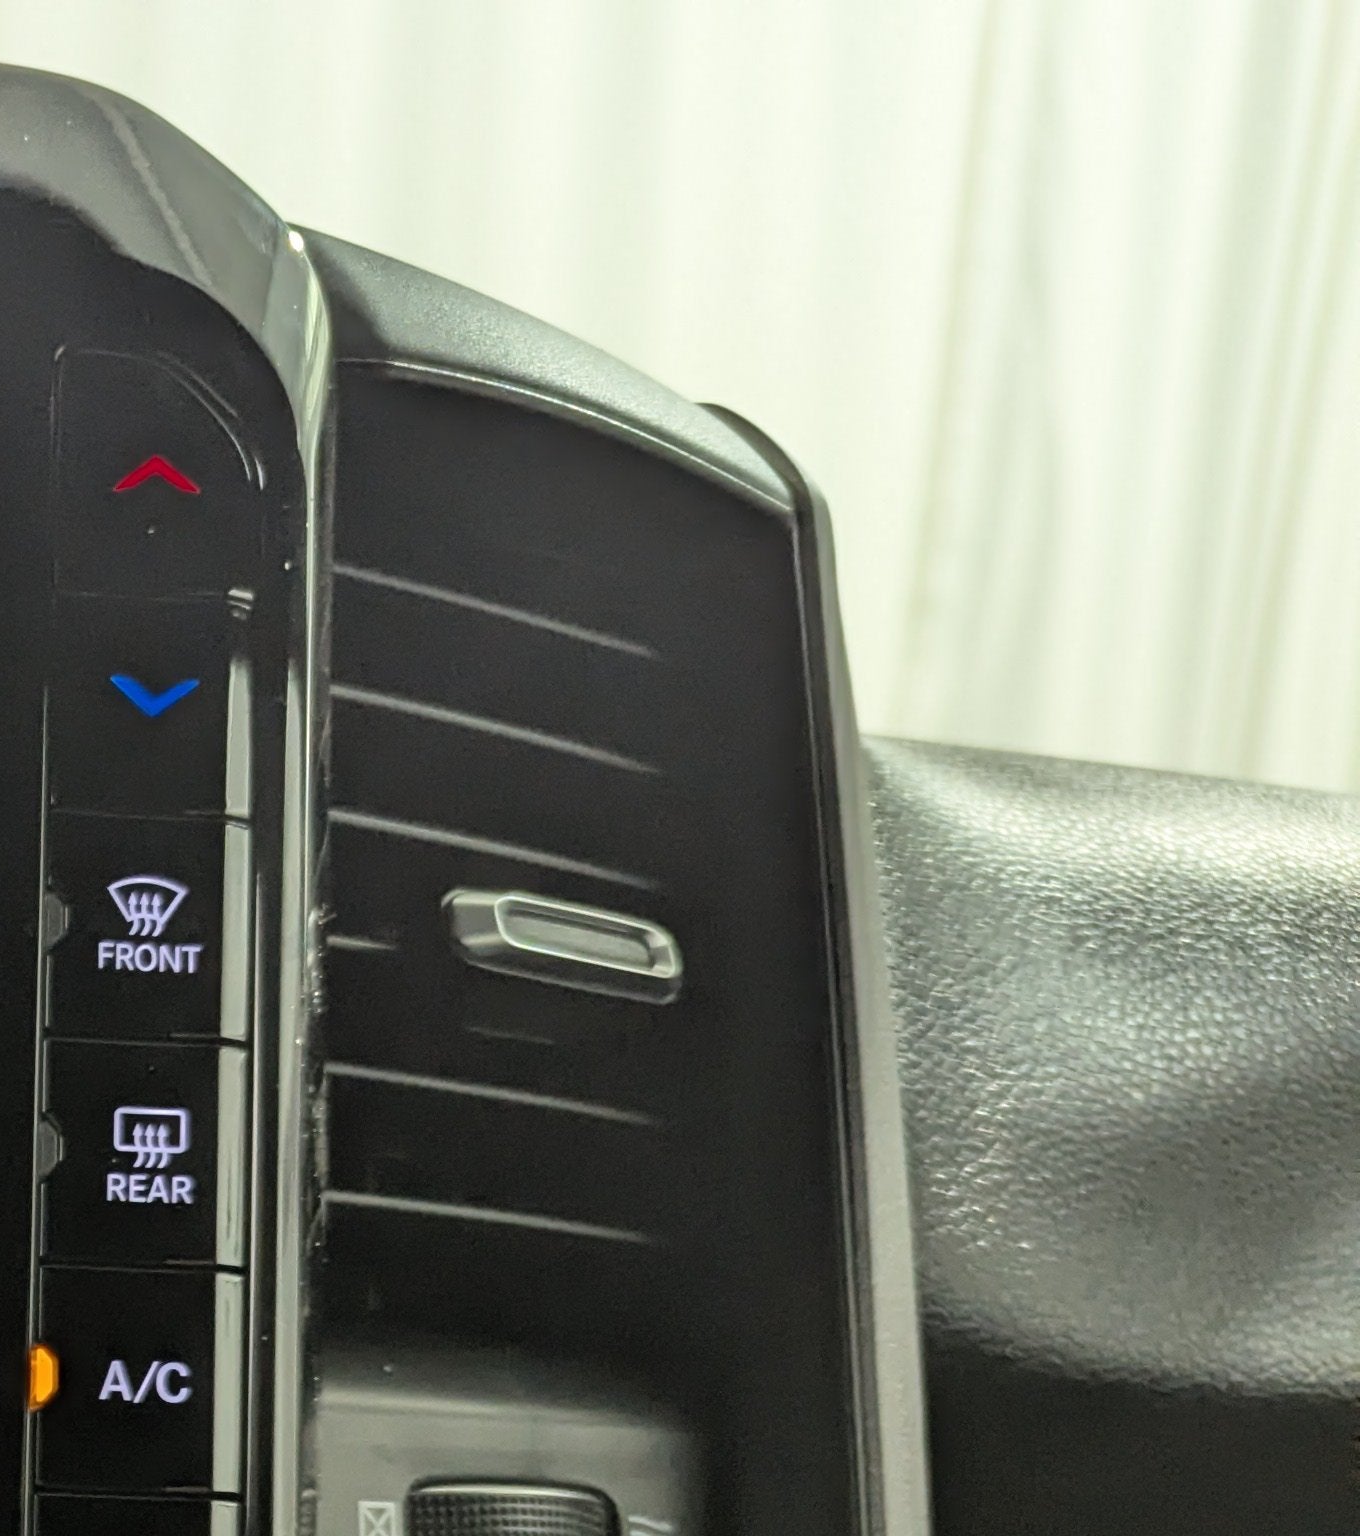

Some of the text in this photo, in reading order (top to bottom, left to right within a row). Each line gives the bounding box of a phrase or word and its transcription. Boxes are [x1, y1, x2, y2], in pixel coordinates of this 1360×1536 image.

[98, 941, 202, 974] FRONT
[106, 1173, 193, 1204] REAR
[98, 1360, 191, 1404] A/C
